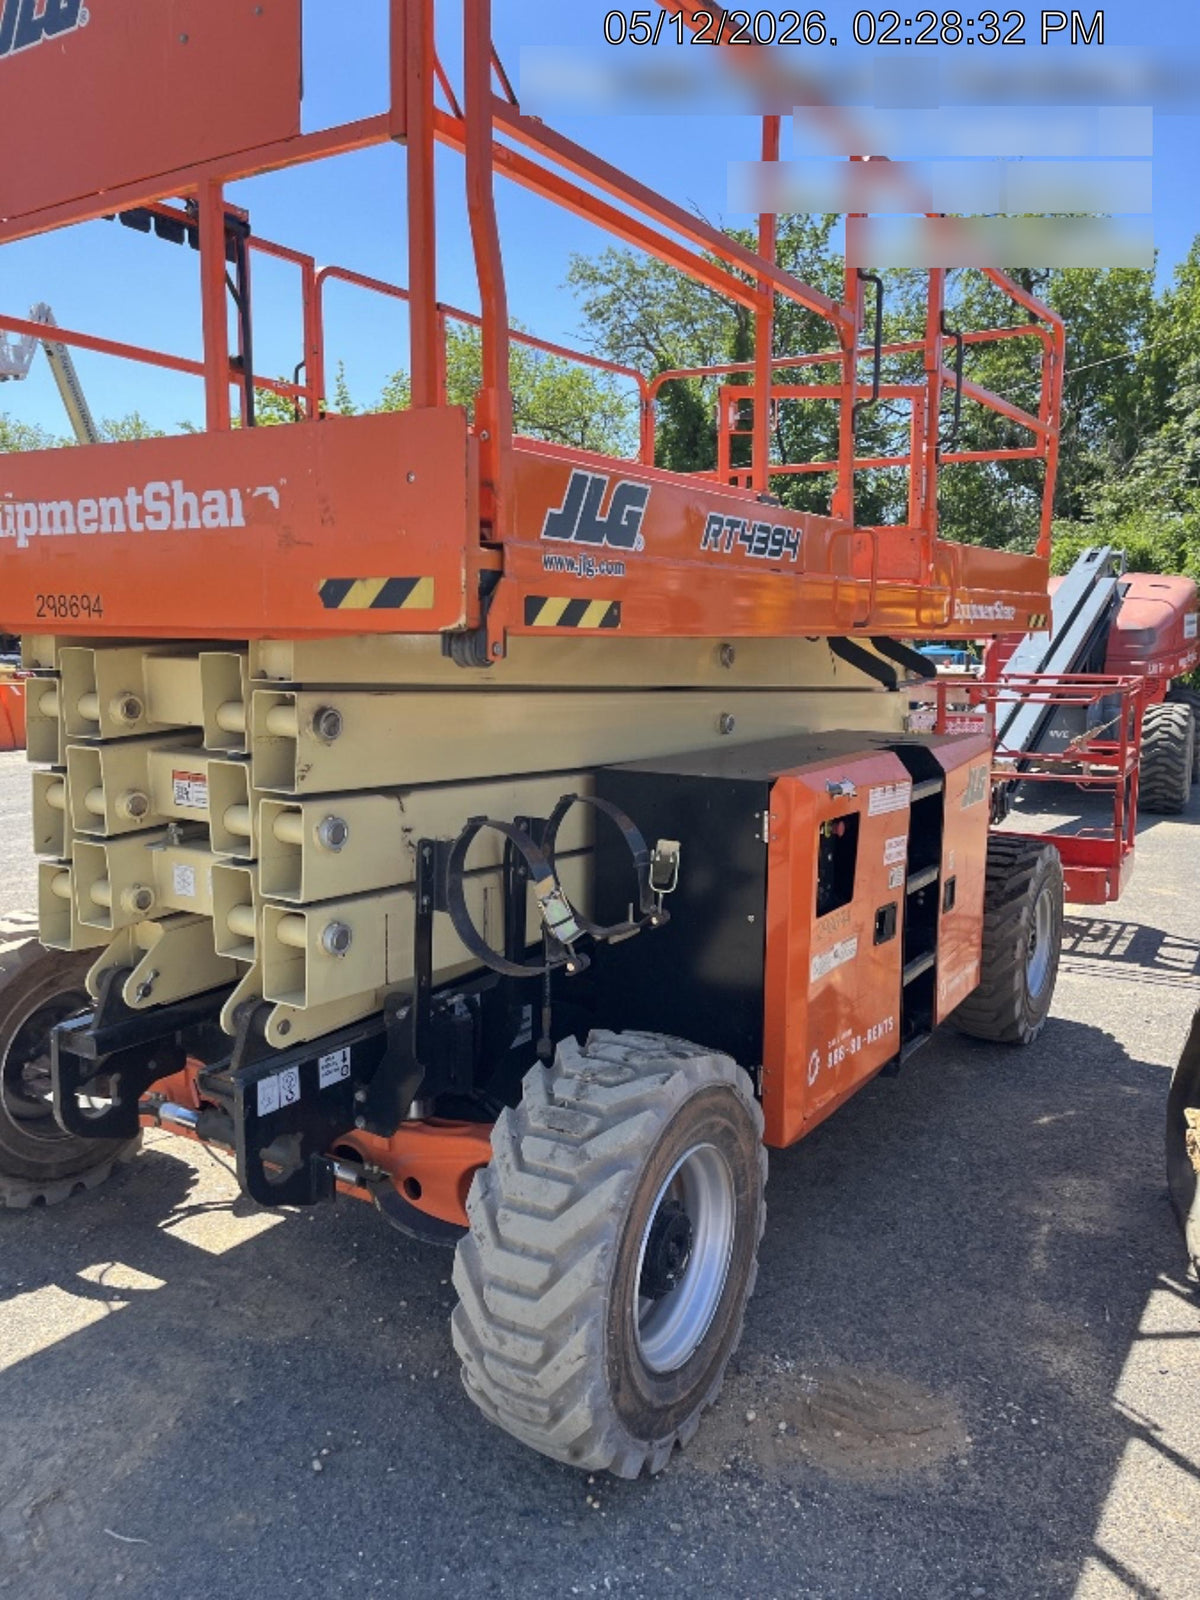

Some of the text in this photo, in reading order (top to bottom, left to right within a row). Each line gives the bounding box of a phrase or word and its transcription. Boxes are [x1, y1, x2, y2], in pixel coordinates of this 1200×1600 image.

[541, 468, 651, 551] JLG
[700, 511, 802, 562] RT4394
[542, 552, 627, 578] www.jlg.com
[36, 594, 103, 618] 298694
